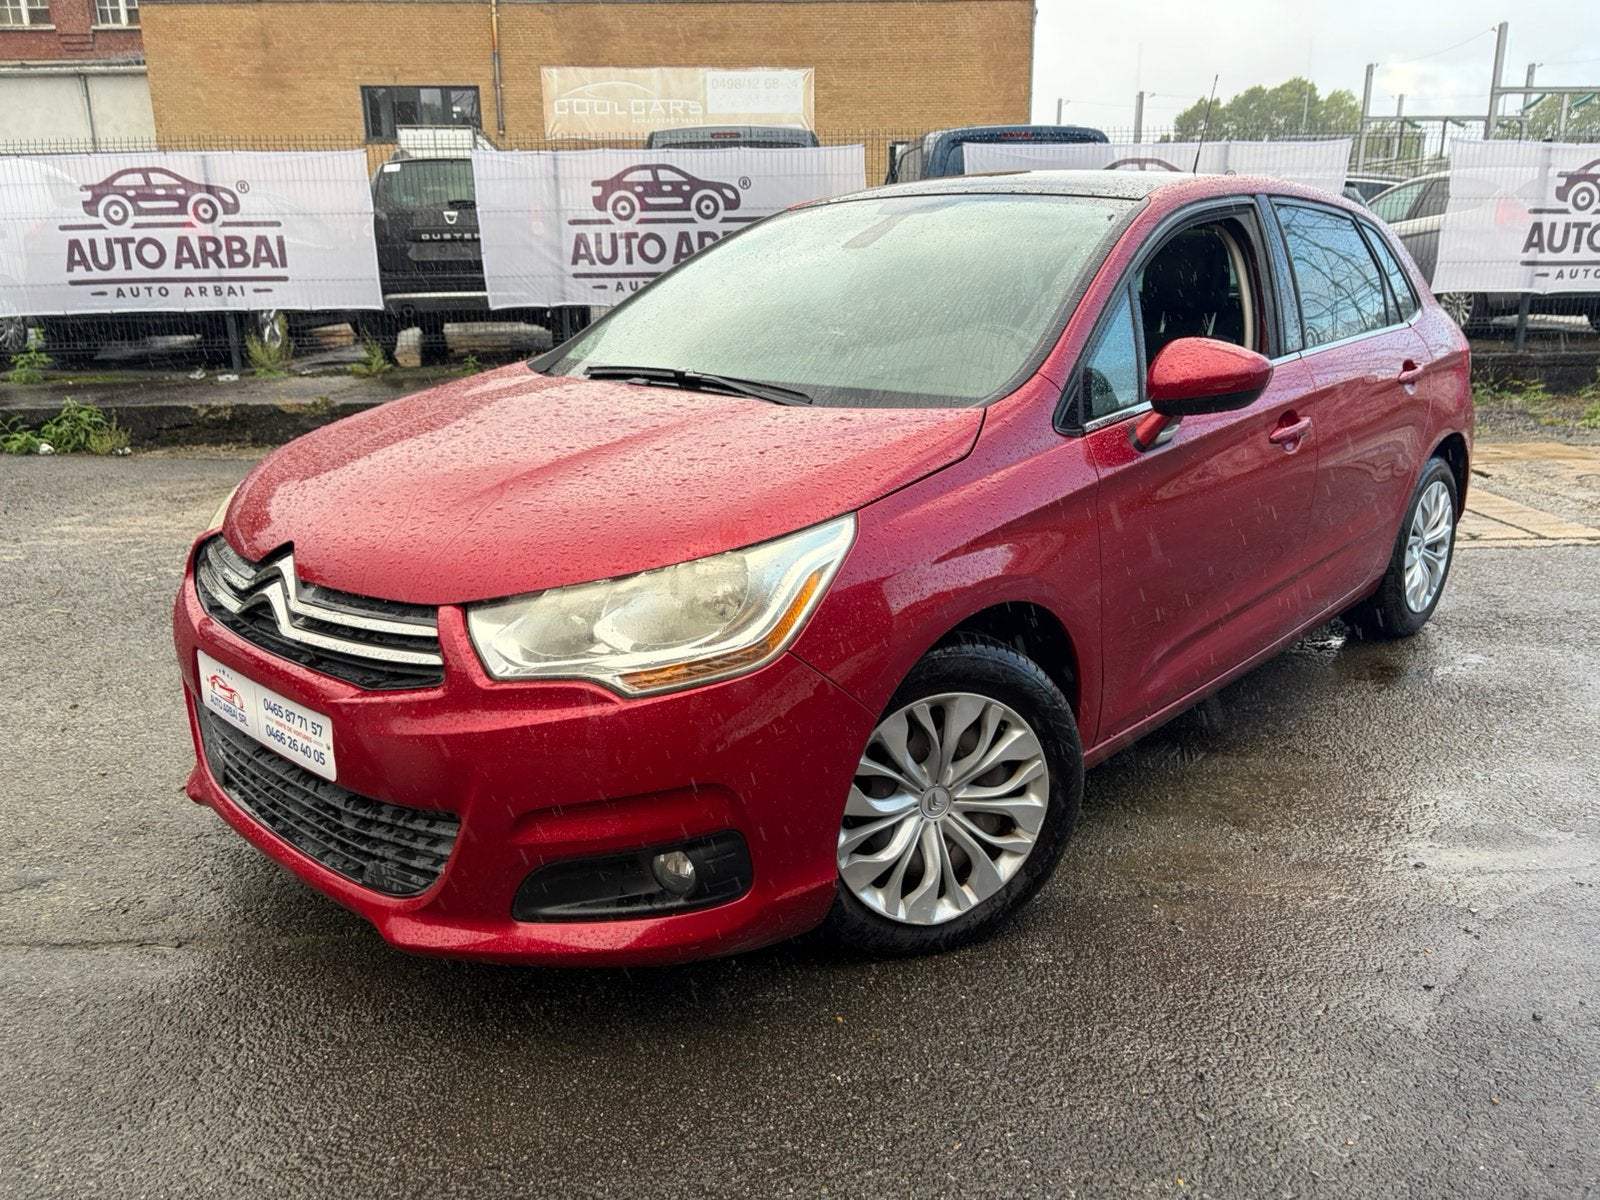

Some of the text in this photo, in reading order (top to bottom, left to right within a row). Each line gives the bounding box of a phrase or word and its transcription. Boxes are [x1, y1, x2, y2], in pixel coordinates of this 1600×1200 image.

[66, 235, 288, 272] AUTO ARBAI
[571, 232, 667, 266] AUTO
[116, 285, 245, 299] AUTO ARBAI
[210, 694, 223, 710] AUTO
[238, 712, 249, 727] SRL
[263, 698, 324, 738] 0465 87 71 57
[265, 724, 326, 766] 0466 26 40 05
